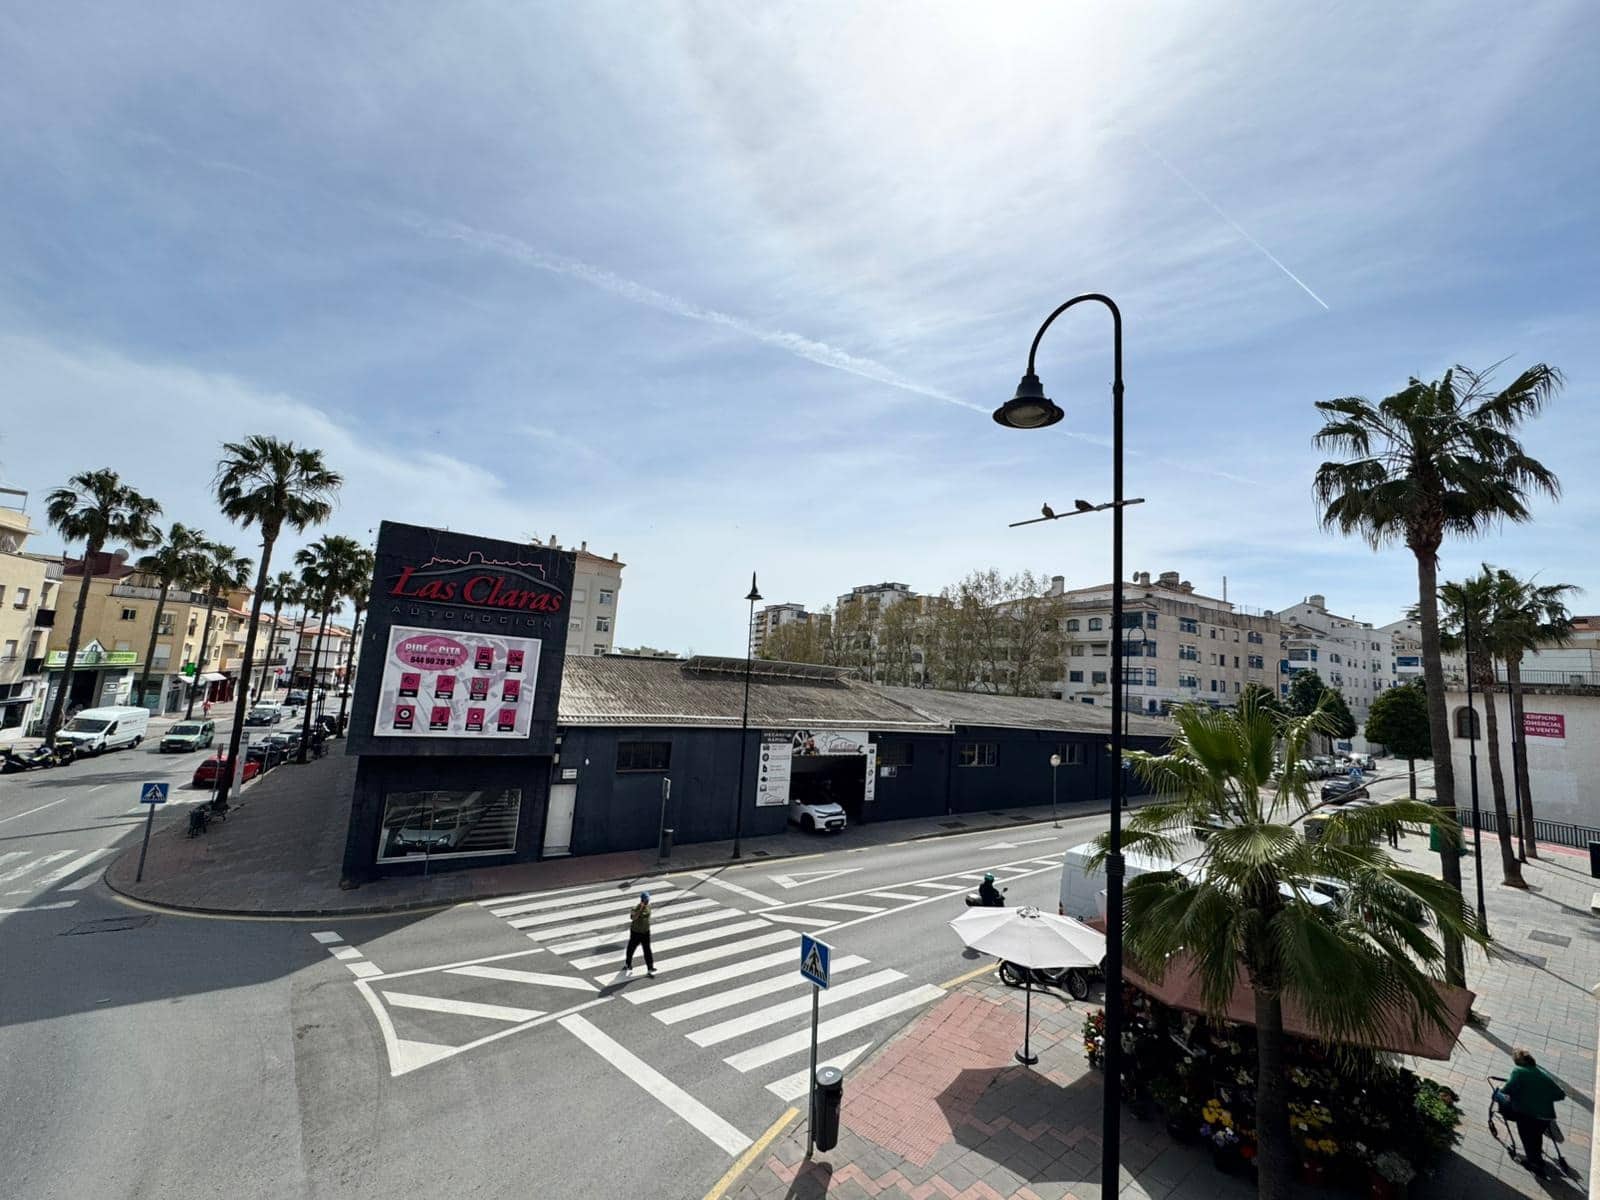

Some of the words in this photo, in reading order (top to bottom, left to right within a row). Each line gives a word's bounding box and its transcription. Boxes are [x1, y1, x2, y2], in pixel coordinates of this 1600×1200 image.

[388, 566, 457, 600] Las
[463, 575, 562, 613] Claras
[405, 643, 429, 653] PIDE
[439, 646, 461, 655] CITA
